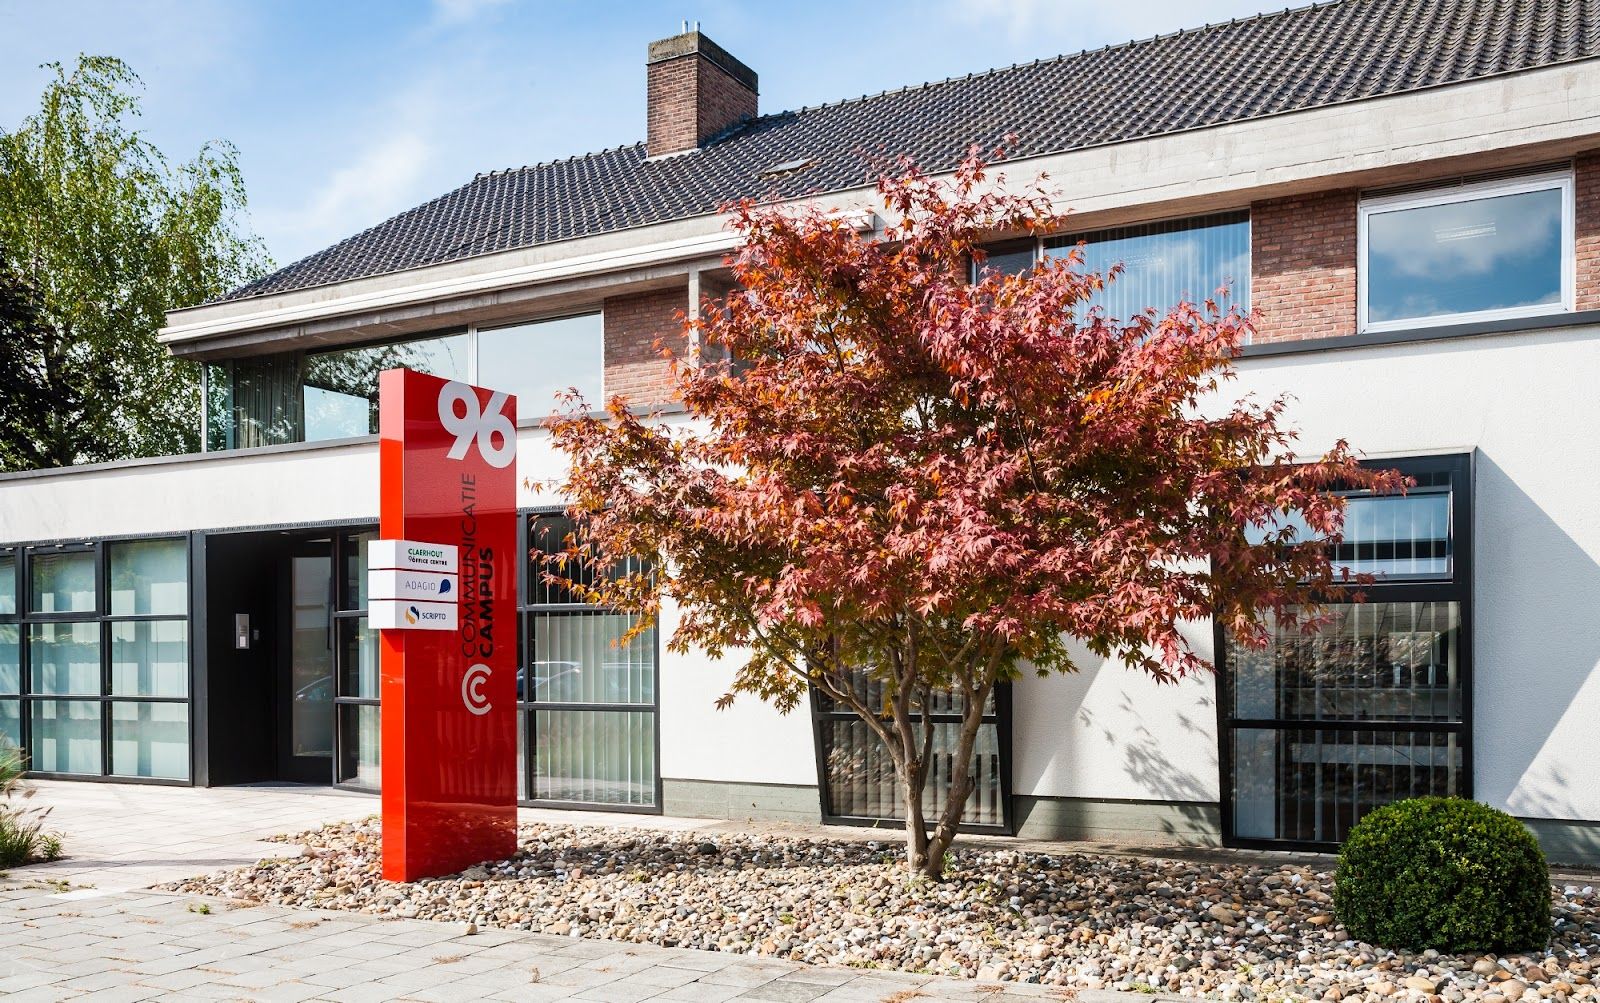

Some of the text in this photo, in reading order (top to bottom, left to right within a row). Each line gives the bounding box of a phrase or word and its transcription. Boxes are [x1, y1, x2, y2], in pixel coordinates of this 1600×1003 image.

[437, 380, 517, 469] 96
[408, 548, 443, 558] CLAERHOUT
[462, 472, 476, 658] COMMUNICATIE
[405, 580, 436, 591] ADAGIO
[479, 547, 493, 658] CAMPUS
[422, 612, 446, 620] SCRIPTO
